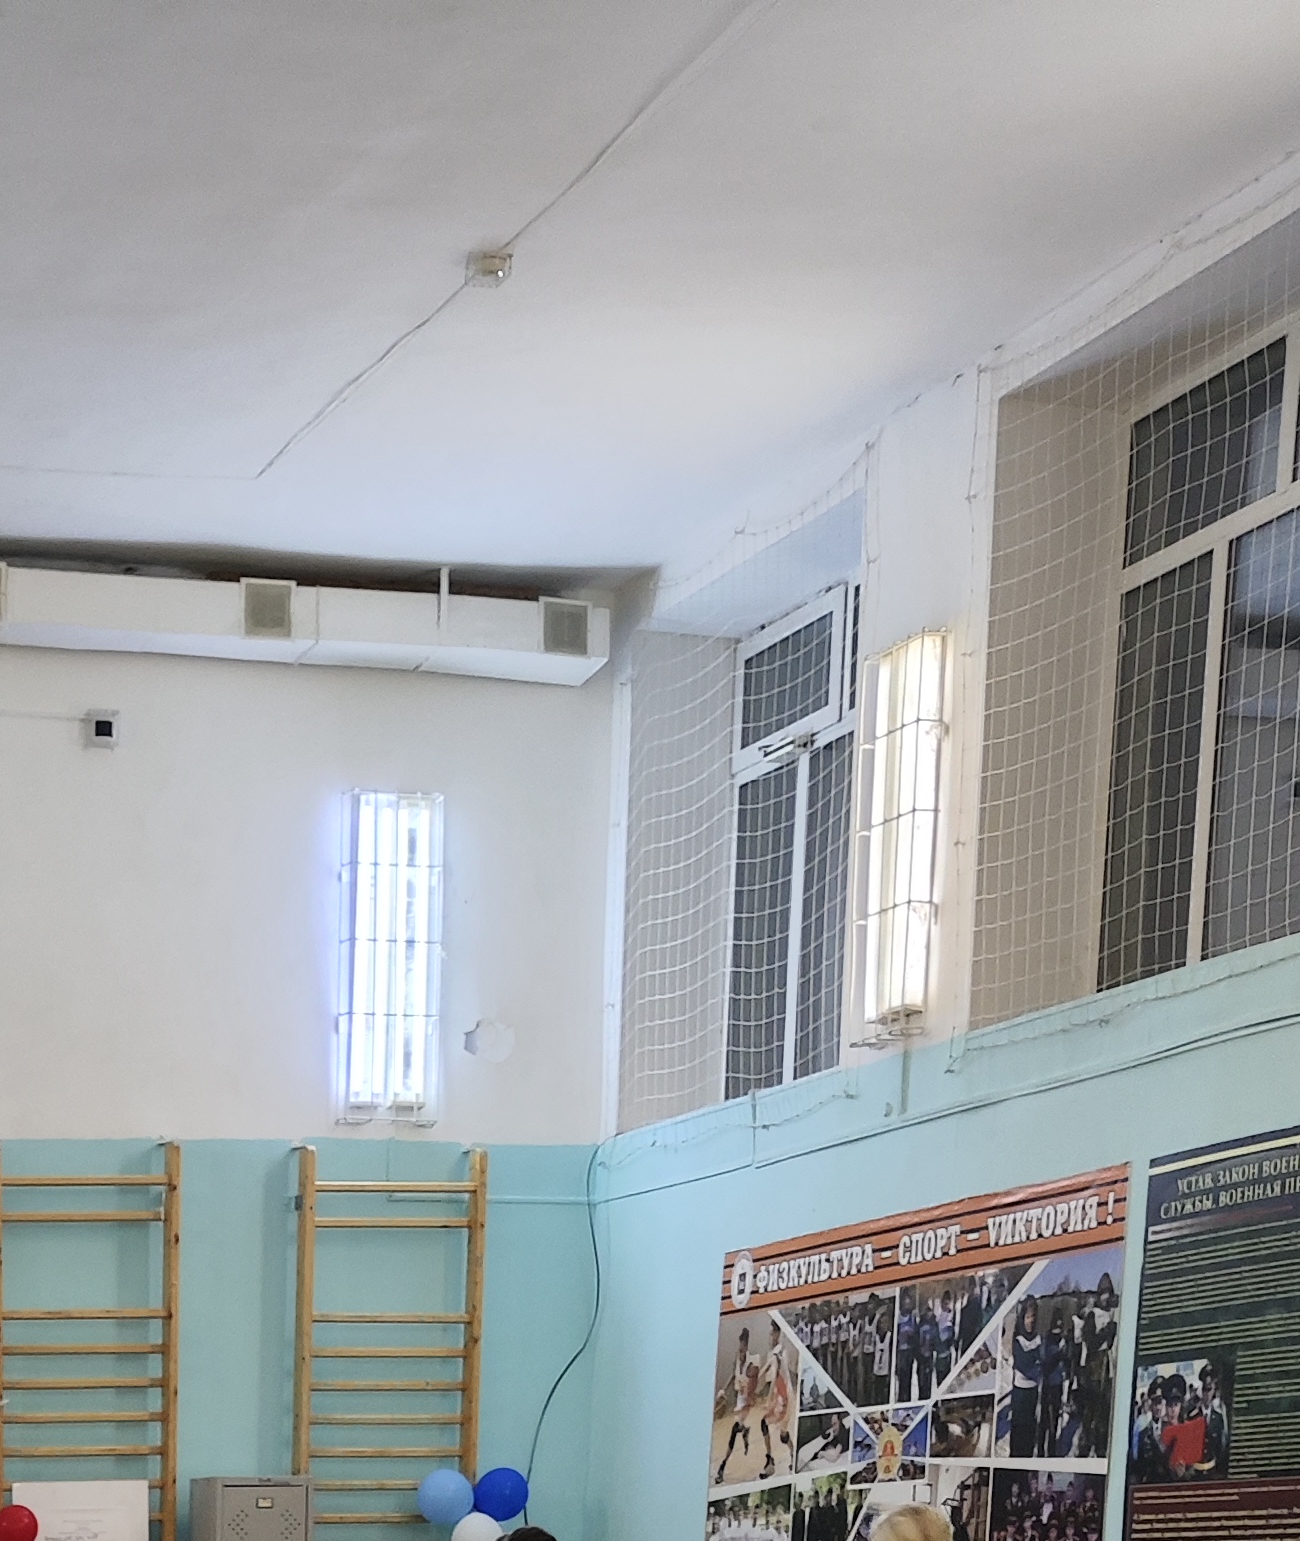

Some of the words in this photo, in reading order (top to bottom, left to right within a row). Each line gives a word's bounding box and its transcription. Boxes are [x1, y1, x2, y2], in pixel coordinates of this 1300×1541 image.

[1217, 1162, 1259, 1187] ЗАКОН
[1219, 1179, 1281, 1207] ВОЕННАЯ
[756, 1243, 874, 1294] ФИЗКУЛЬТУРА
[898, 1224, 961, 1266] СПОРТ
